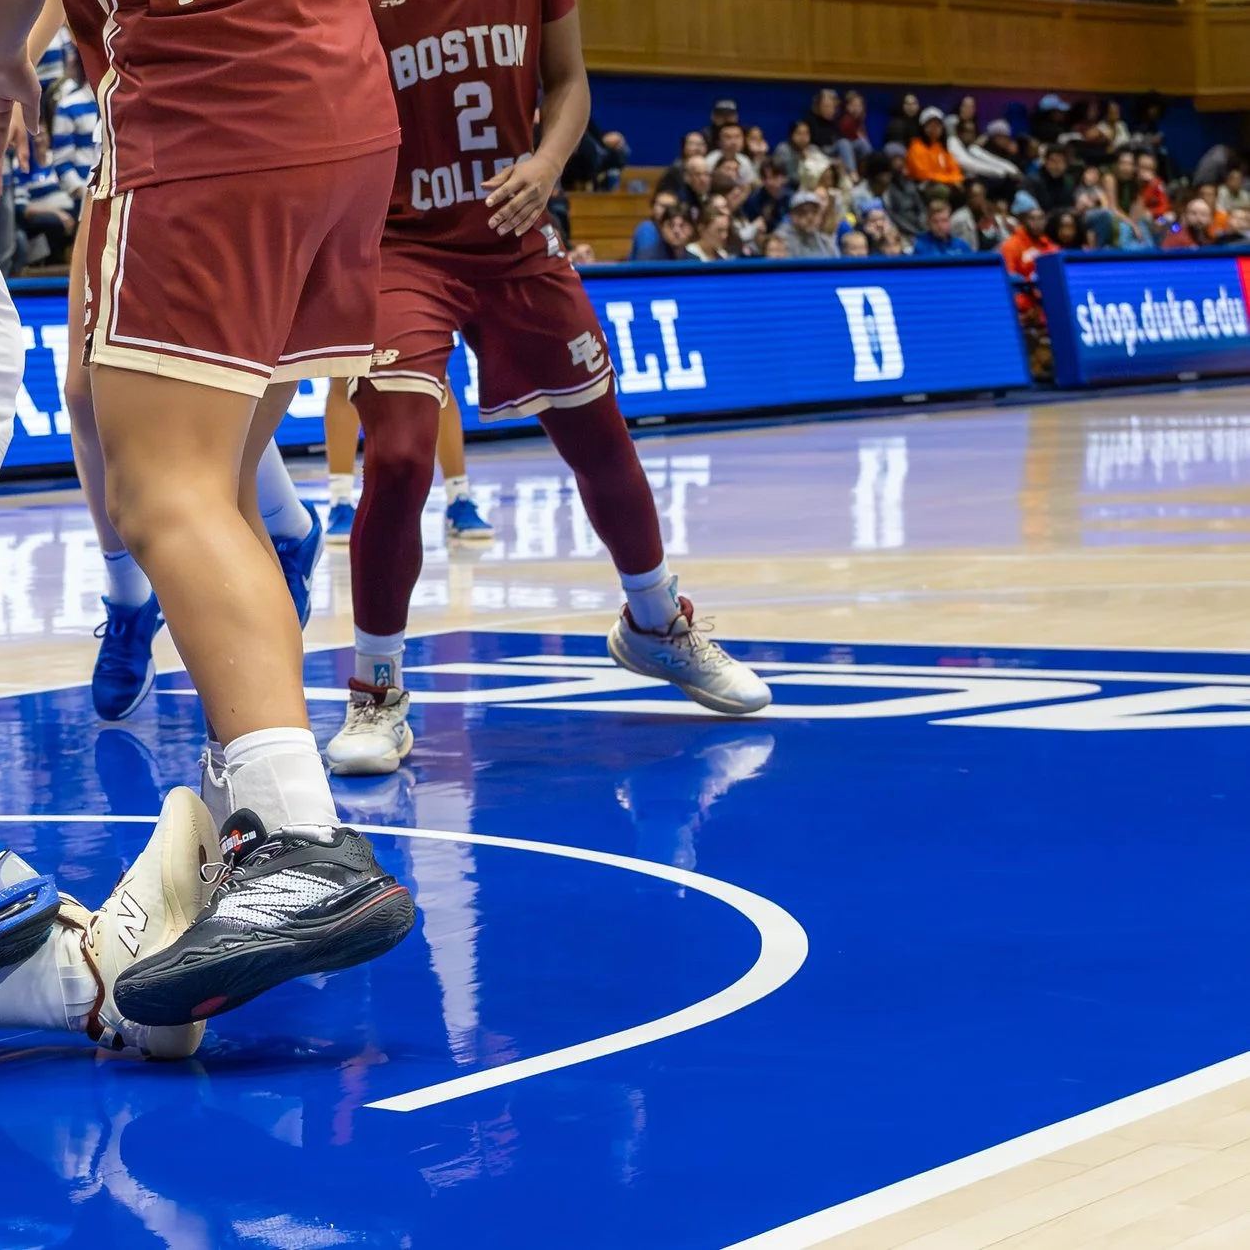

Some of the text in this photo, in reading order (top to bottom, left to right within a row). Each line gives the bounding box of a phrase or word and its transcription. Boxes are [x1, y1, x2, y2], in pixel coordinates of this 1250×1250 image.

[390, 24, 528, 91] BOSTON
[453, 80, 498, 152] 2
[1076, 285, 1249, 357] shop.duke.edu
